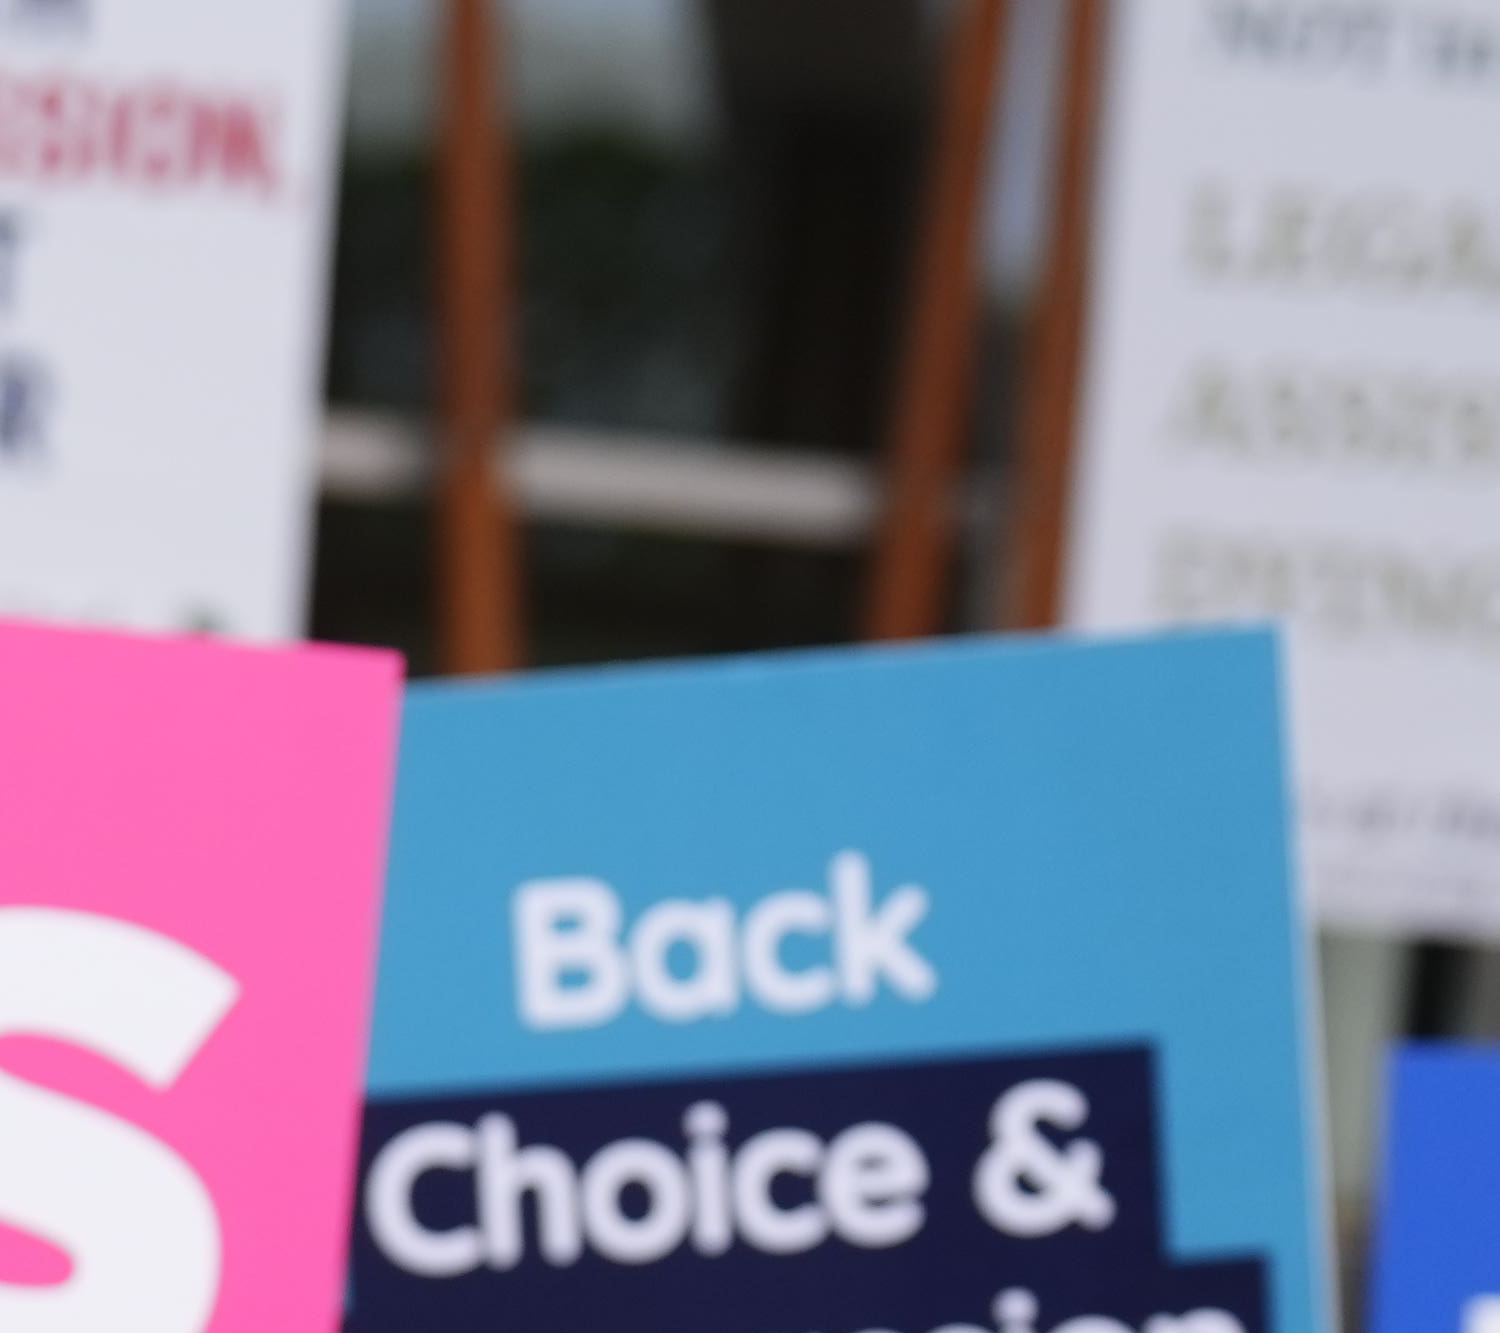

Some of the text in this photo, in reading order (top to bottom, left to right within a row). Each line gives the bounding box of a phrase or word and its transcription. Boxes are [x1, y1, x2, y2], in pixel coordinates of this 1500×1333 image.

[511, 849, 938, 1032] Back
[364, 1077, 1115, 1278] Choice &
